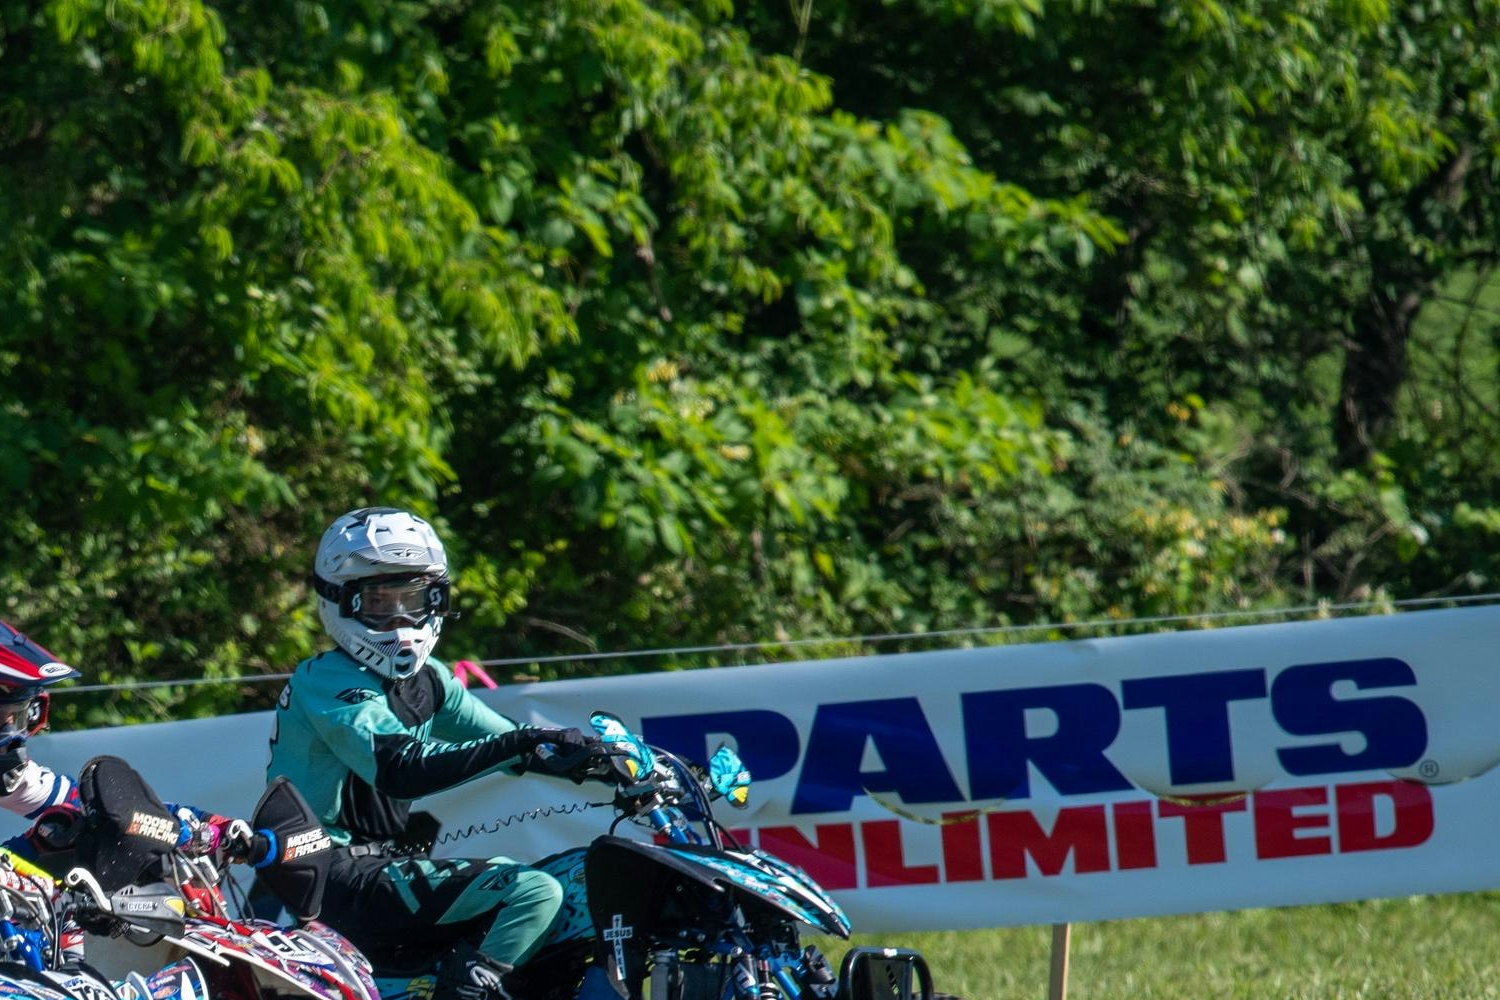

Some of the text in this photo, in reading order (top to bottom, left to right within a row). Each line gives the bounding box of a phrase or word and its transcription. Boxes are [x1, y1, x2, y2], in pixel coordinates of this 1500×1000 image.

[641, 657, 1429, 822] PARTS
[132, 811, 175, 832] MOOSE
[137, 824, 180, 845] RACING
[286, 828, 323, 849] MOOSE
[654, 779, 1435, 890] NLIMITED
[293, 836, 332, 858] RACING
[127, 901, 154, 912] CYCRA
[605, 928, 632, 939] JESUS
